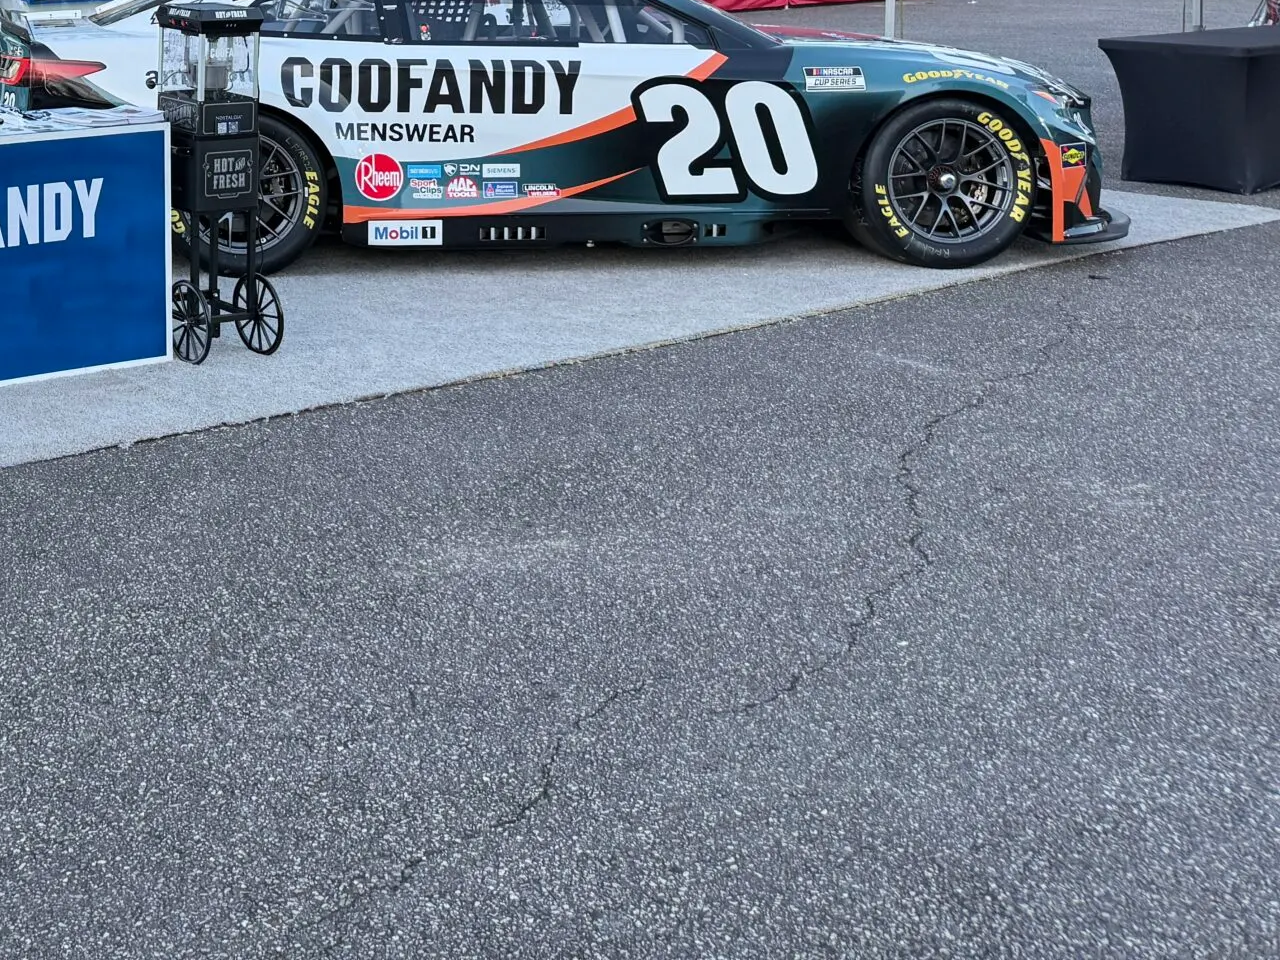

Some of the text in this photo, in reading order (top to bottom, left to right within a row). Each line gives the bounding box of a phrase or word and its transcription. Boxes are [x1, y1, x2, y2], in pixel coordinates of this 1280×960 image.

[822, 68, 853, 76] NASCAR
[902, 68, 1010, 90] GOODYEAR
[281, 56, 581, 115] COOFANDY
[814, 77, 857, 86] CUP SERIES
[335, 122, 475, 143] MENSWEAR
[640, 80, 819, 196] 20
[1063, 151, 1085, 162] SUNOCO
[213, 158, 235, 173] HOT
[360, 154, 400, 187] Rheem
[459, 164, 480, 172] DN
[977, 111, 1030, 223] GOODYEAR
[213, 173, 246, 189] FRESH
[411, 179, 436, 189] Sport
[448, 177, 477, 192] MAC
[420, 186, 441, 194] Clips
[303, 170, 320, 230] EAGLE
[874, 183, 911, 239] EAGLE
[374, 226, 419, 240] Mobil
